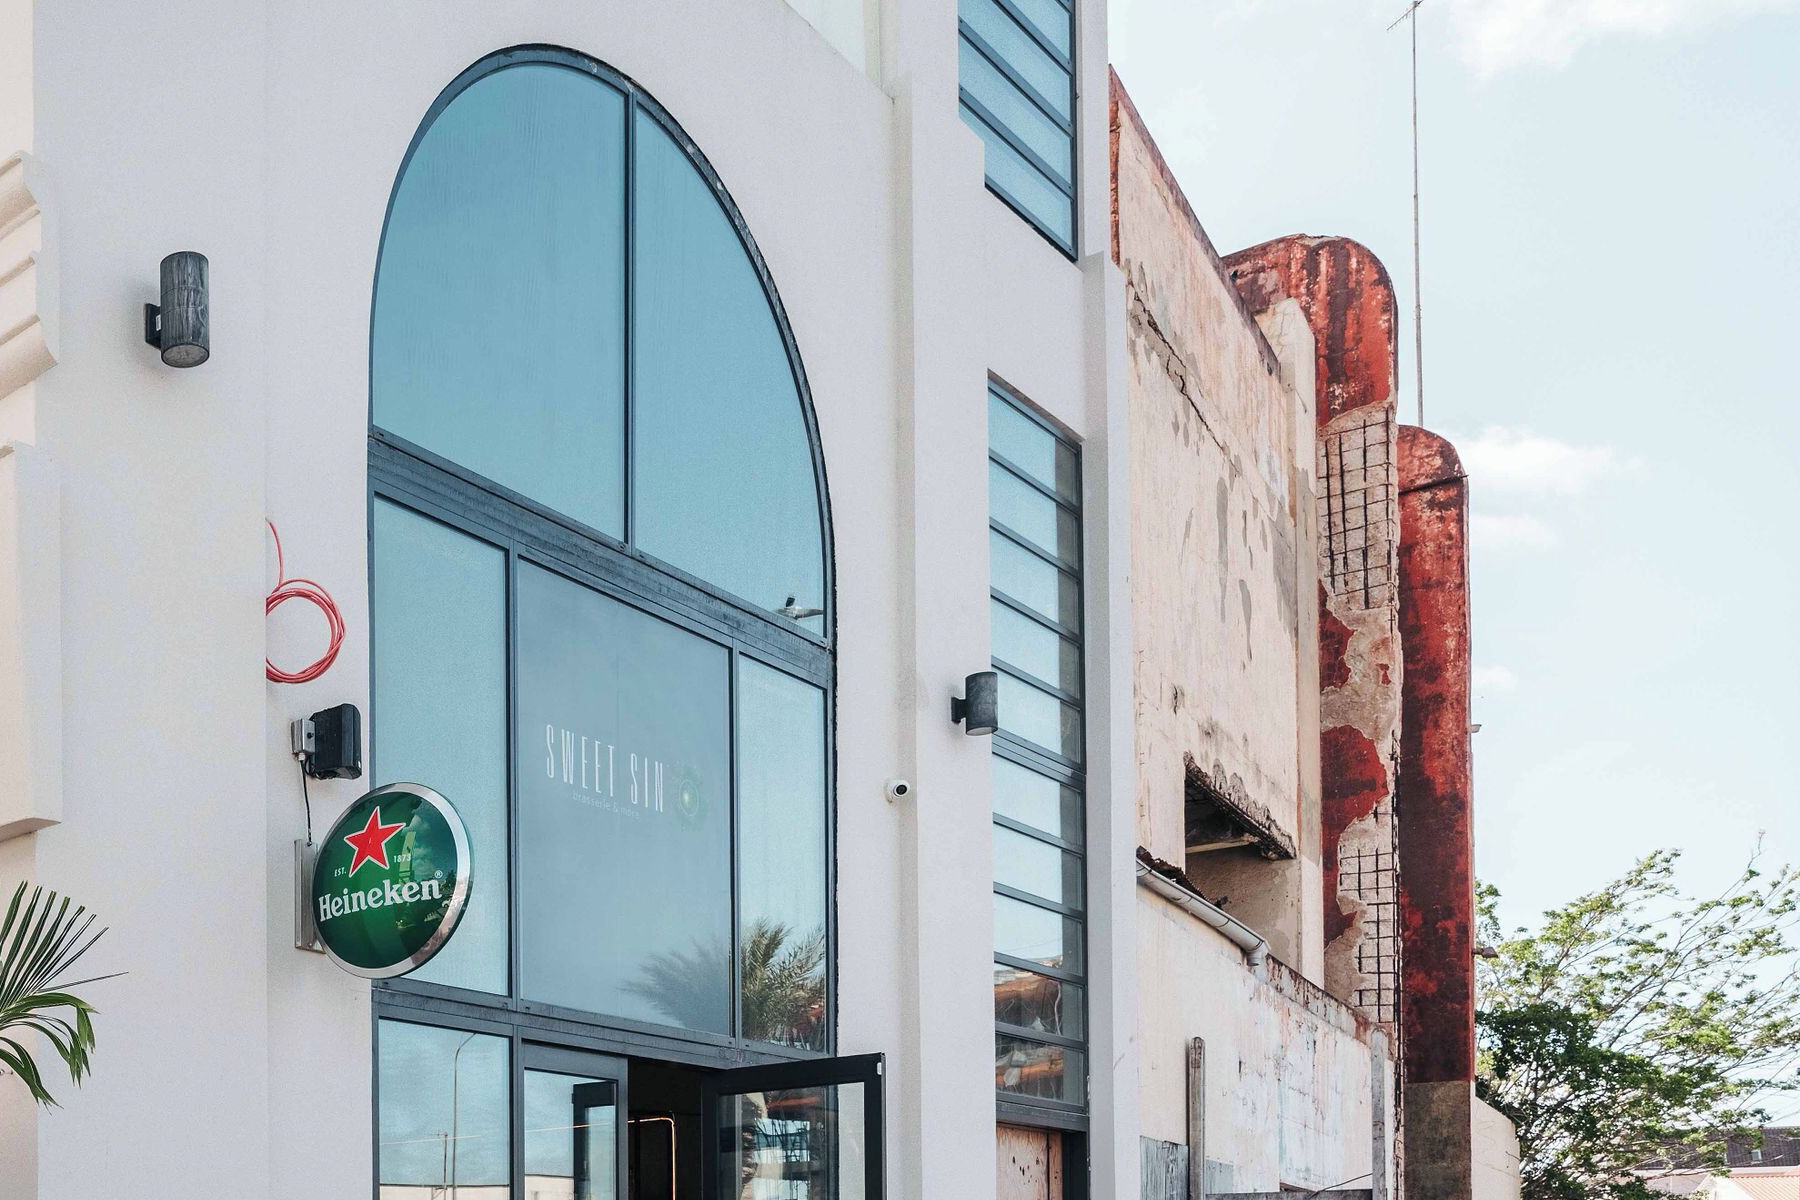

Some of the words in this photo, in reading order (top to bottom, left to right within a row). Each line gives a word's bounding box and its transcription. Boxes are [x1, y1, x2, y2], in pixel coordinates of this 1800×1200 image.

[546, 724, 615, 797] SWEET
[630, 753, 664, 813] SIN
[334, 866, 348, 878] EST.
[393, 854, 412, 863] 1873
[318, 878, 443, 922] Heineken
